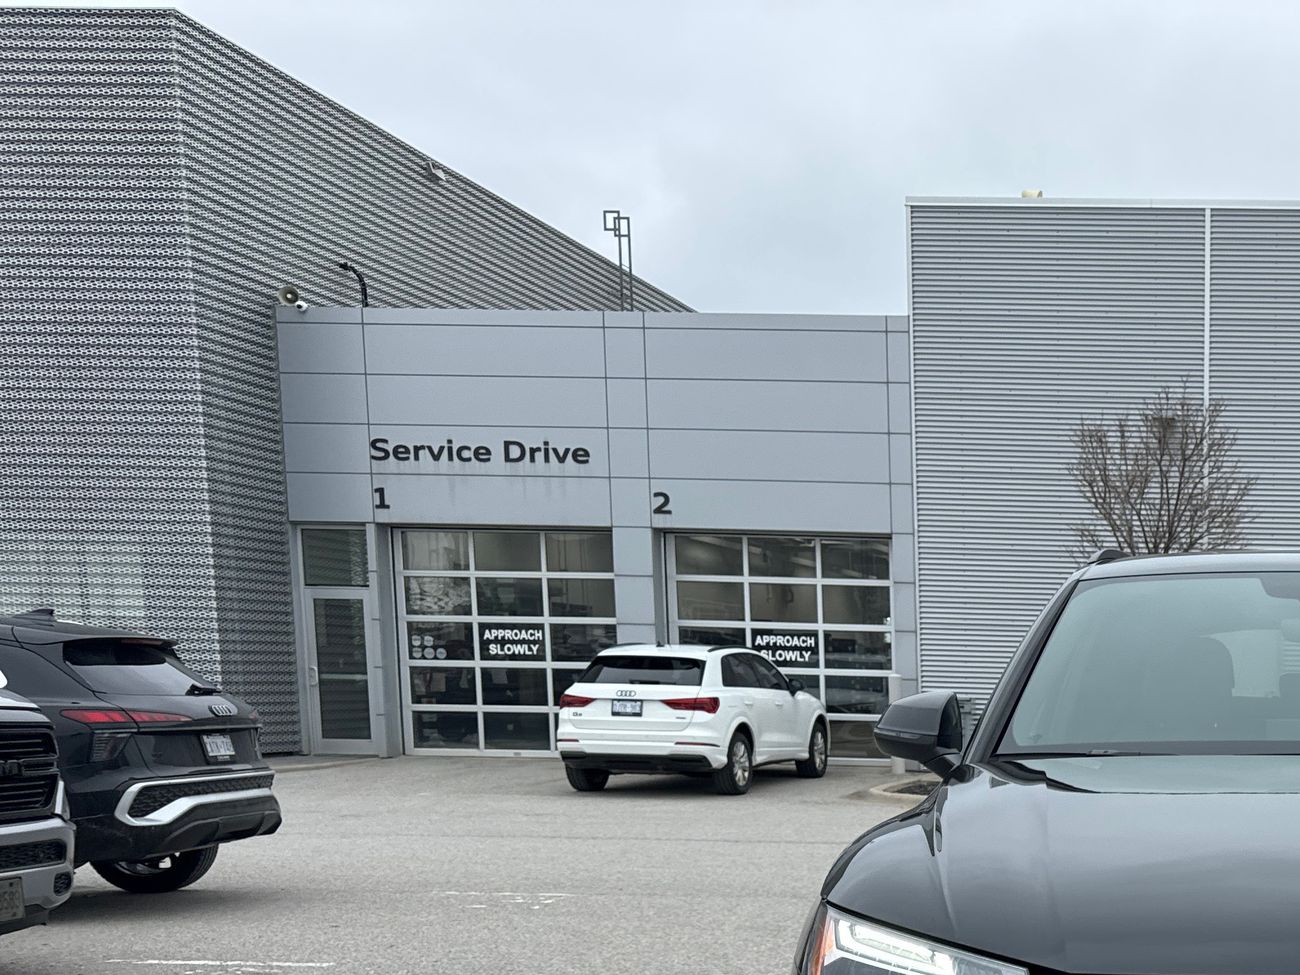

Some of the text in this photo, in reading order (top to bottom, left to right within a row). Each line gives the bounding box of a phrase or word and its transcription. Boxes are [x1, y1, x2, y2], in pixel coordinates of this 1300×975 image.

[370, 438, 591, 464] Service Drive
[374, 487, 390, 509] 1
[653, 492, 672, 514] 2
[483, 629, 542, 640] APPROACH
[755, 635, 815, 647] APPROACH
[488, 644, 539, 655] SLOWLY
[760, 649, 811, 662] SLOWLY
